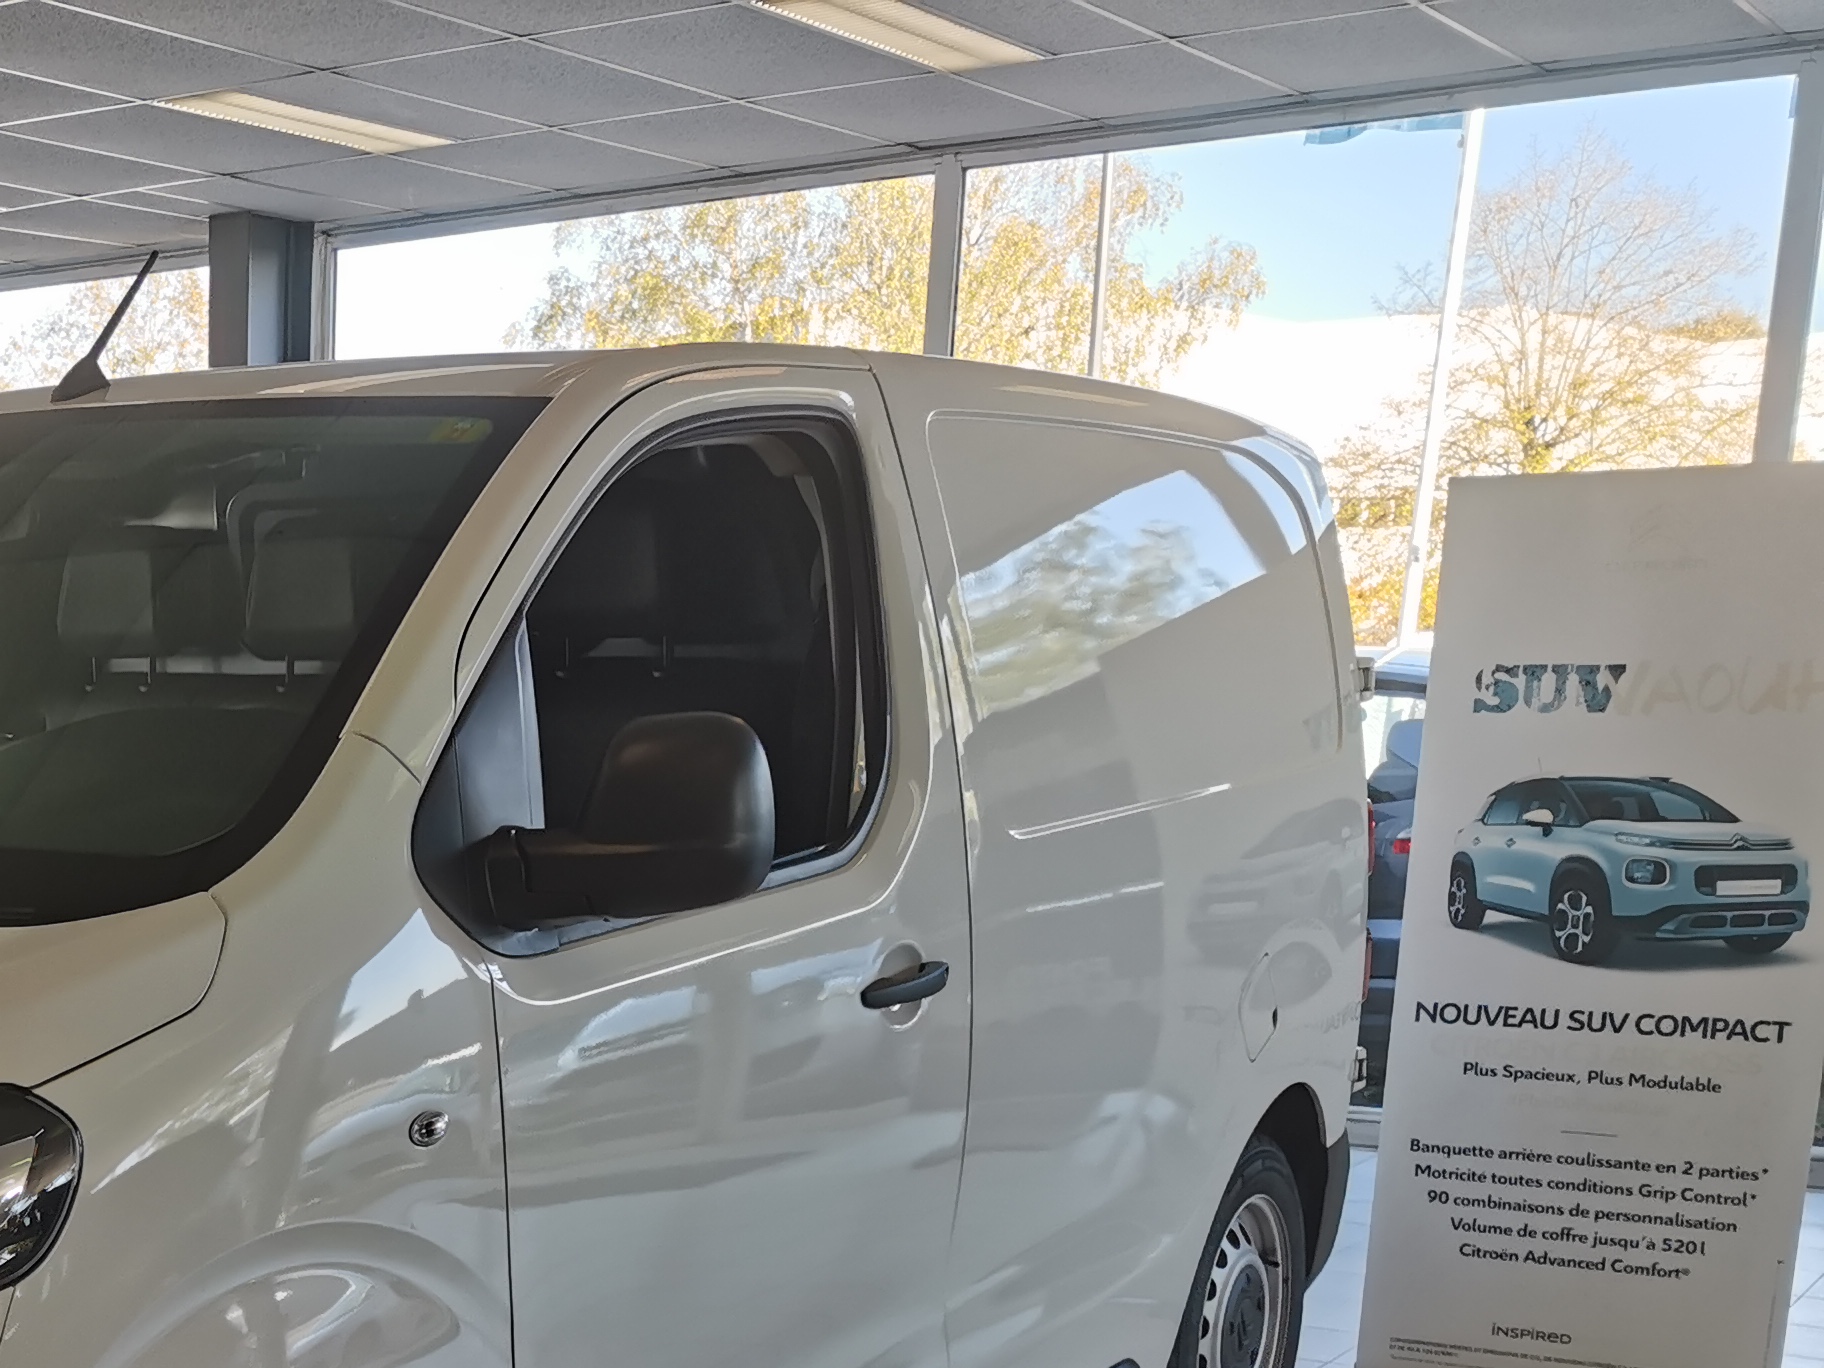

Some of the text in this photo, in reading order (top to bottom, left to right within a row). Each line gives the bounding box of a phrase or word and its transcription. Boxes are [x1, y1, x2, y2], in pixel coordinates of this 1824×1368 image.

[1414, 1001, 1792, 1044] NOUVEAU SUV COMPACT
[1463, 1061, 1722, 1094] Plus Spacieux, Plus Modulable
[1410, 1138, 1494, 1159] Banquette
[1498, 1148, 1553, 1164] arrière
[1556, 1152, 1652, 1172] coulissante
[1655, 1162, 1677, 1175] en
[1681, 1160, 1694, 1176] 2
[1414, 1163, 1487, 1184] Motricité
[1491, 1172, 1543, 1188] toutes
[1547, 1177, 1634, 1197] conditions
[1638, 1183, 1676, 1203] Grip
[1427, 1190, 1738, 1233] 90 combinaisons de personnalisation
[1450, 1217, 1514, 1237] Volume
[1517, 1222, 1538, 1239] de
[1541, 1226, 1589, 1245] coffre
[1459, 1242, 1519, 1263] Citroën
[1523, 1249, 1607, 1272] Advanced
